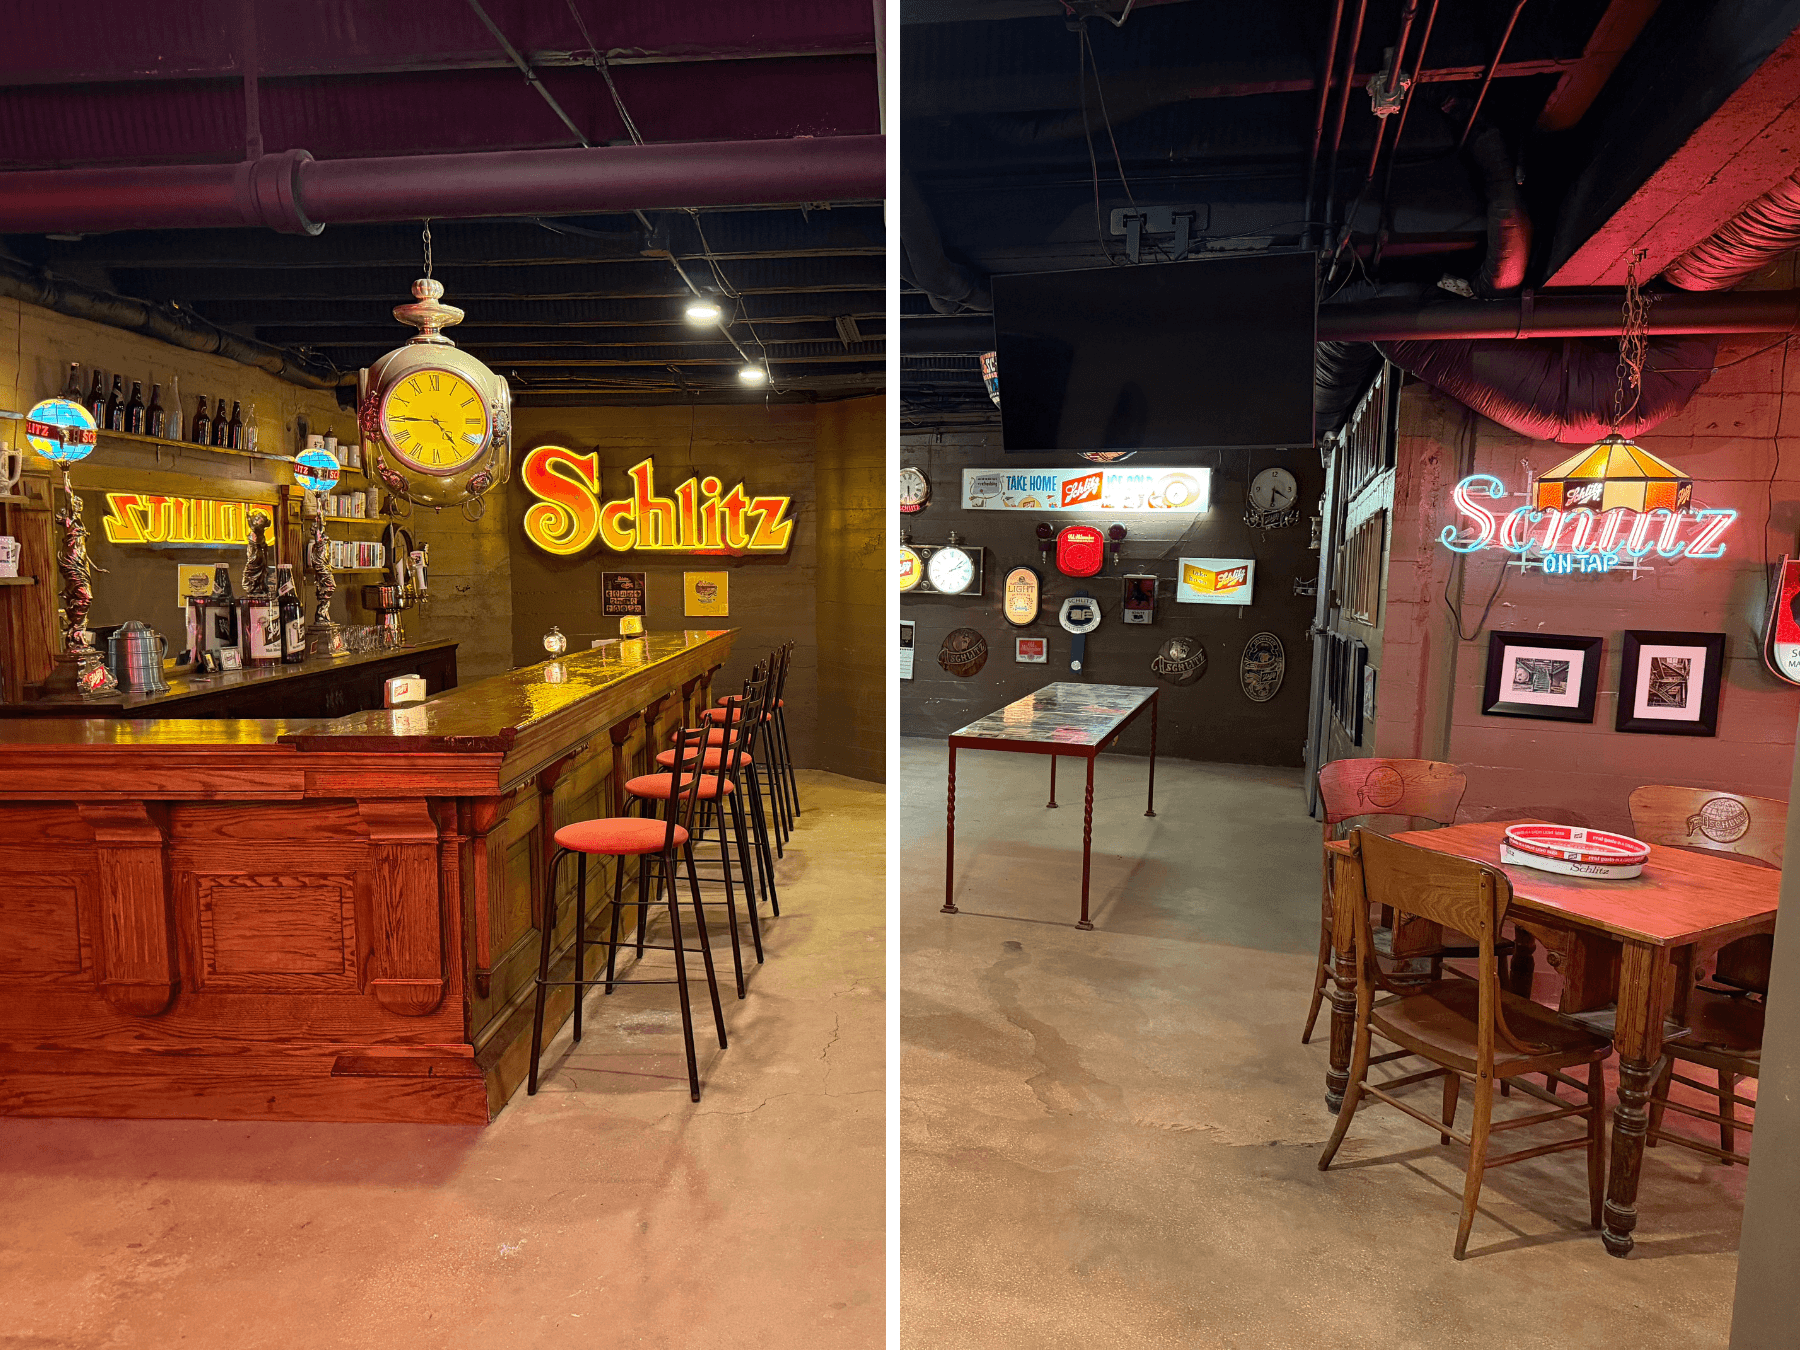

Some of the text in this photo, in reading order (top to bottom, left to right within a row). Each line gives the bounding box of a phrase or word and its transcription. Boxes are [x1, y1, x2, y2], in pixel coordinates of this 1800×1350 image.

[1006, 475, 1058, 492] TAKE HOME
[1063, 476, 1101, 504] Schlitz
[1564, 482, 1604, 506] Schlitz
[521, 445, 794, 556] Schlitz
[1542, 553, 1620, 574] ON TAP
[1008, 585, 1035, 593] LIGHT
[1569, 863, 1610, 875] Schlitz
